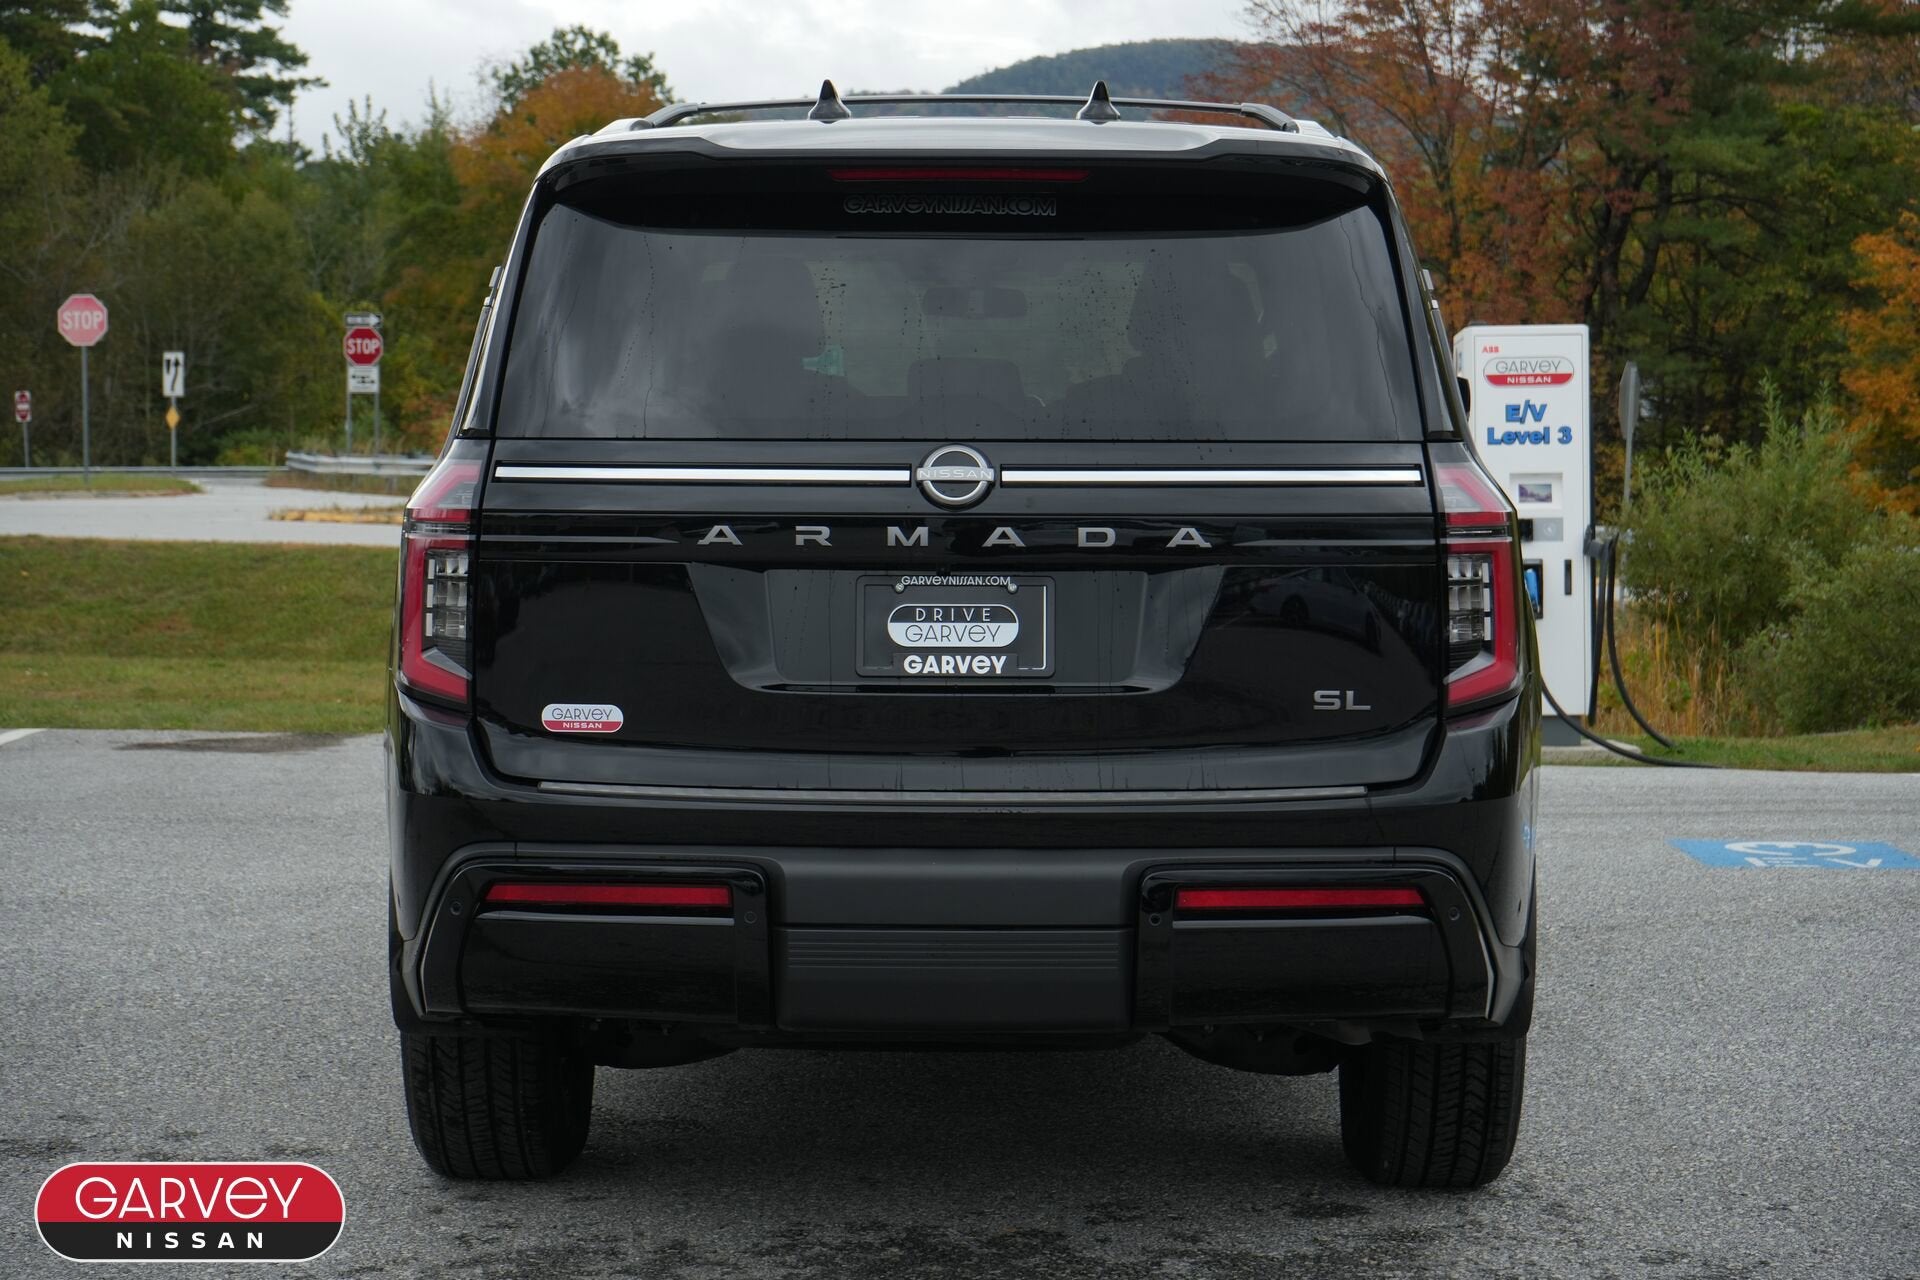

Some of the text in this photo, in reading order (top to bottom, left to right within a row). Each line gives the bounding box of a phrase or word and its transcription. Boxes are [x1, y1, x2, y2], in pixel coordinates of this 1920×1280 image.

[62, 310, 104, 330] STOP
[347, 337, 381, 355] STOP
[1506, 375, 1552, 384] NISSAN
[1505, 399, 1547, 424] E/V
[1487, 426, 1573, 445] Level 3
[919, 469, 992, 479] NISSAN
[697, 524, 1212, 548] ARMADA
[915, 607, 991, 622] DRIVE
[1313, 690, 1371, 710] SL
